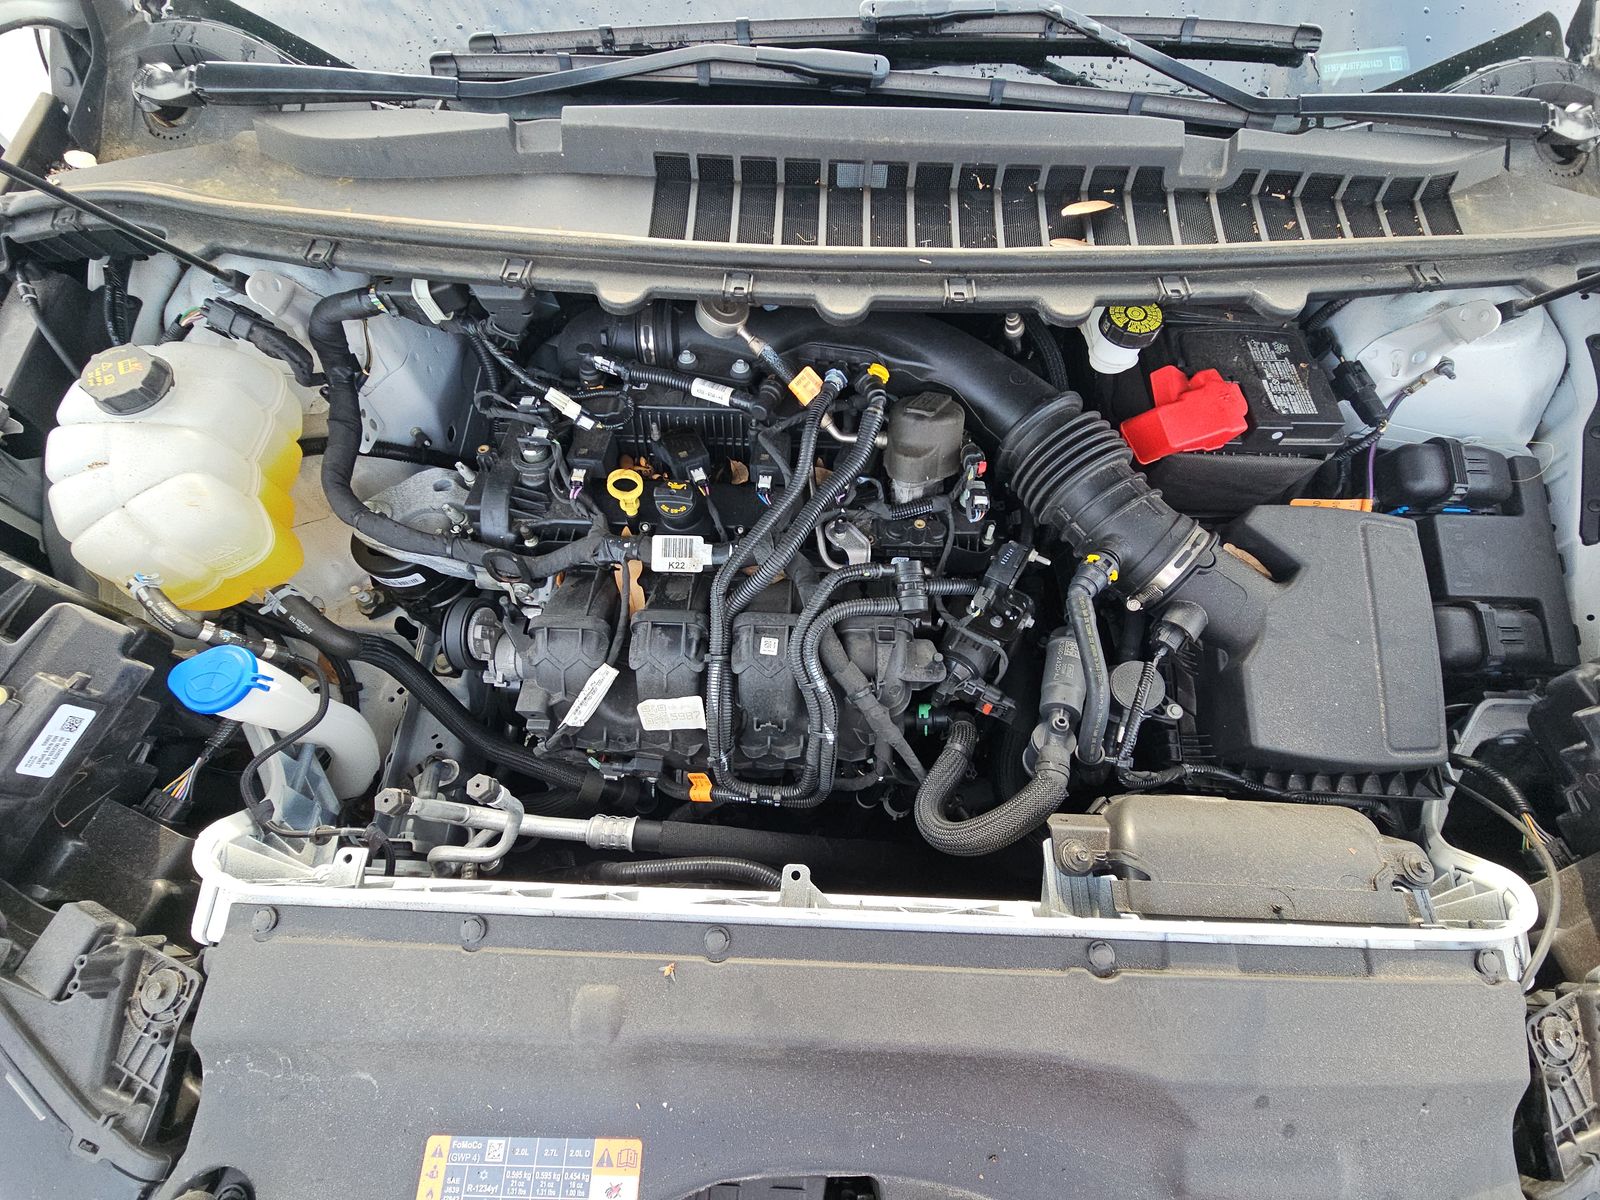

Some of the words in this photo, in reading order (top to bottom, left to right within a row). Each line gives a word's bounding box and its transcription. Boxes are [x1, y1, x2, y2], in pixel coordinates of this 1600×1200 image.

[668, 561, 686, 570] K22
[452, 1140, 483, 1149] FoMoCo
[515, 1148, 529, 1156] 2.0L
[544, 1149, 559, 1157] 2.7L
[569, 1149, 583, 1157] 2.0L
[584, 1150, 591, 1158] D
[448, 1153, 471, 1163] (GWP
[472, 1154, 481, 1164] 4)
[523, 1171, 531, 1181] kg
[552, 1172, 561, 1182] kg
[564, 1172, 582, 1181] 0.454
[582, 1173, 590, 1183] kg
[446, 1177, 460, 1185] SAE
[467, 1184, 498, 1195] R-1234yf
